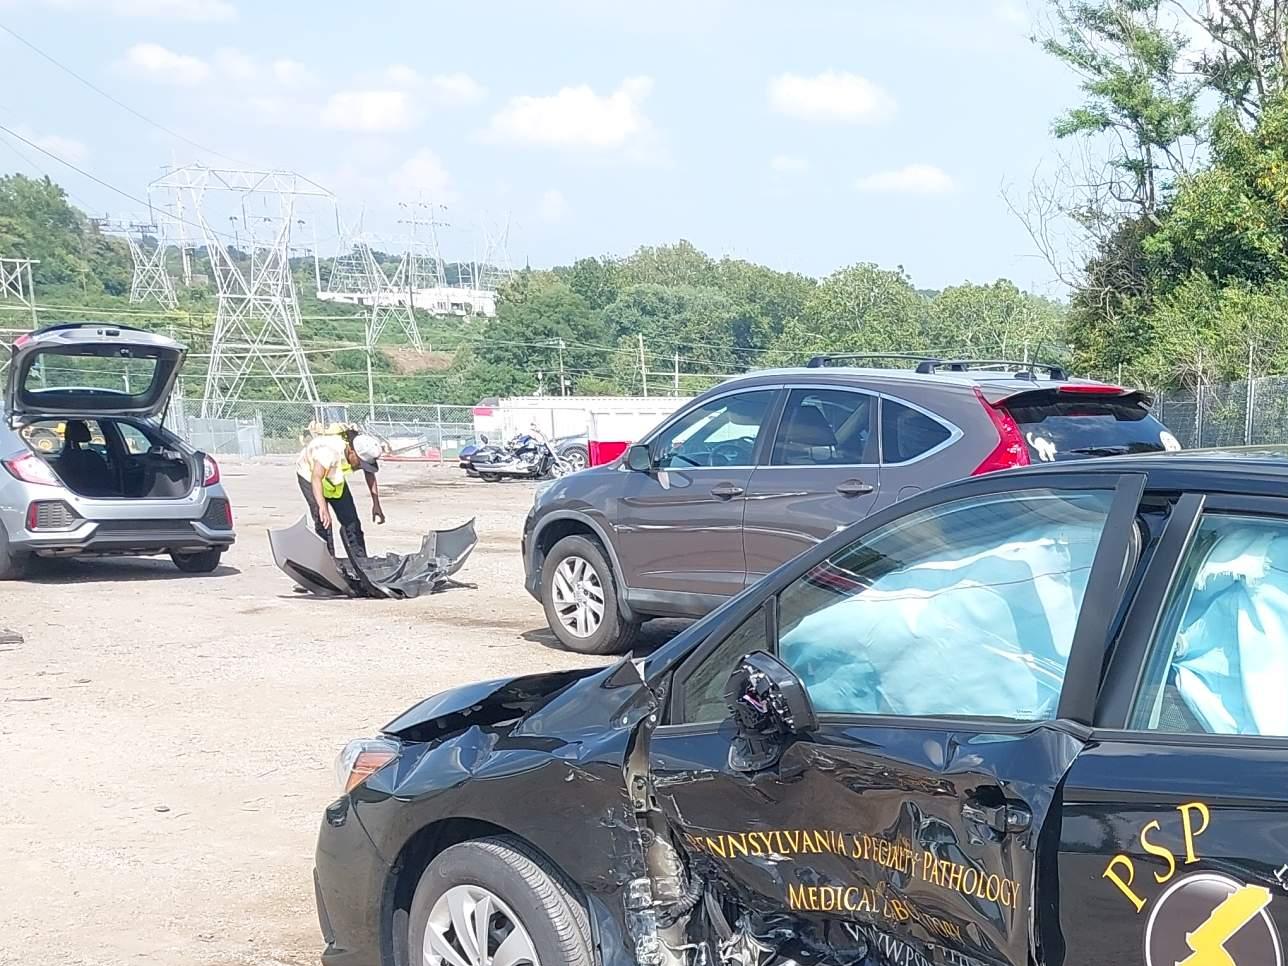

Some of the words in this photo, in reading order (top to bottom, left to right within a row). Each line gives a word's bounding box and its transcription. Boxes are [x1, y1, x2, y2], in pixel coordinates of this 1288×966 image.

[686, 830, 847, 859] PENNSYLVANIA
[923, 850, 1021, 909] PATHOLOGY
[1102, 801, 1211, 914] PSP
[788, 882, 880, 913] MEDICAL
[883, 897, 966, 944] LABOTORY
